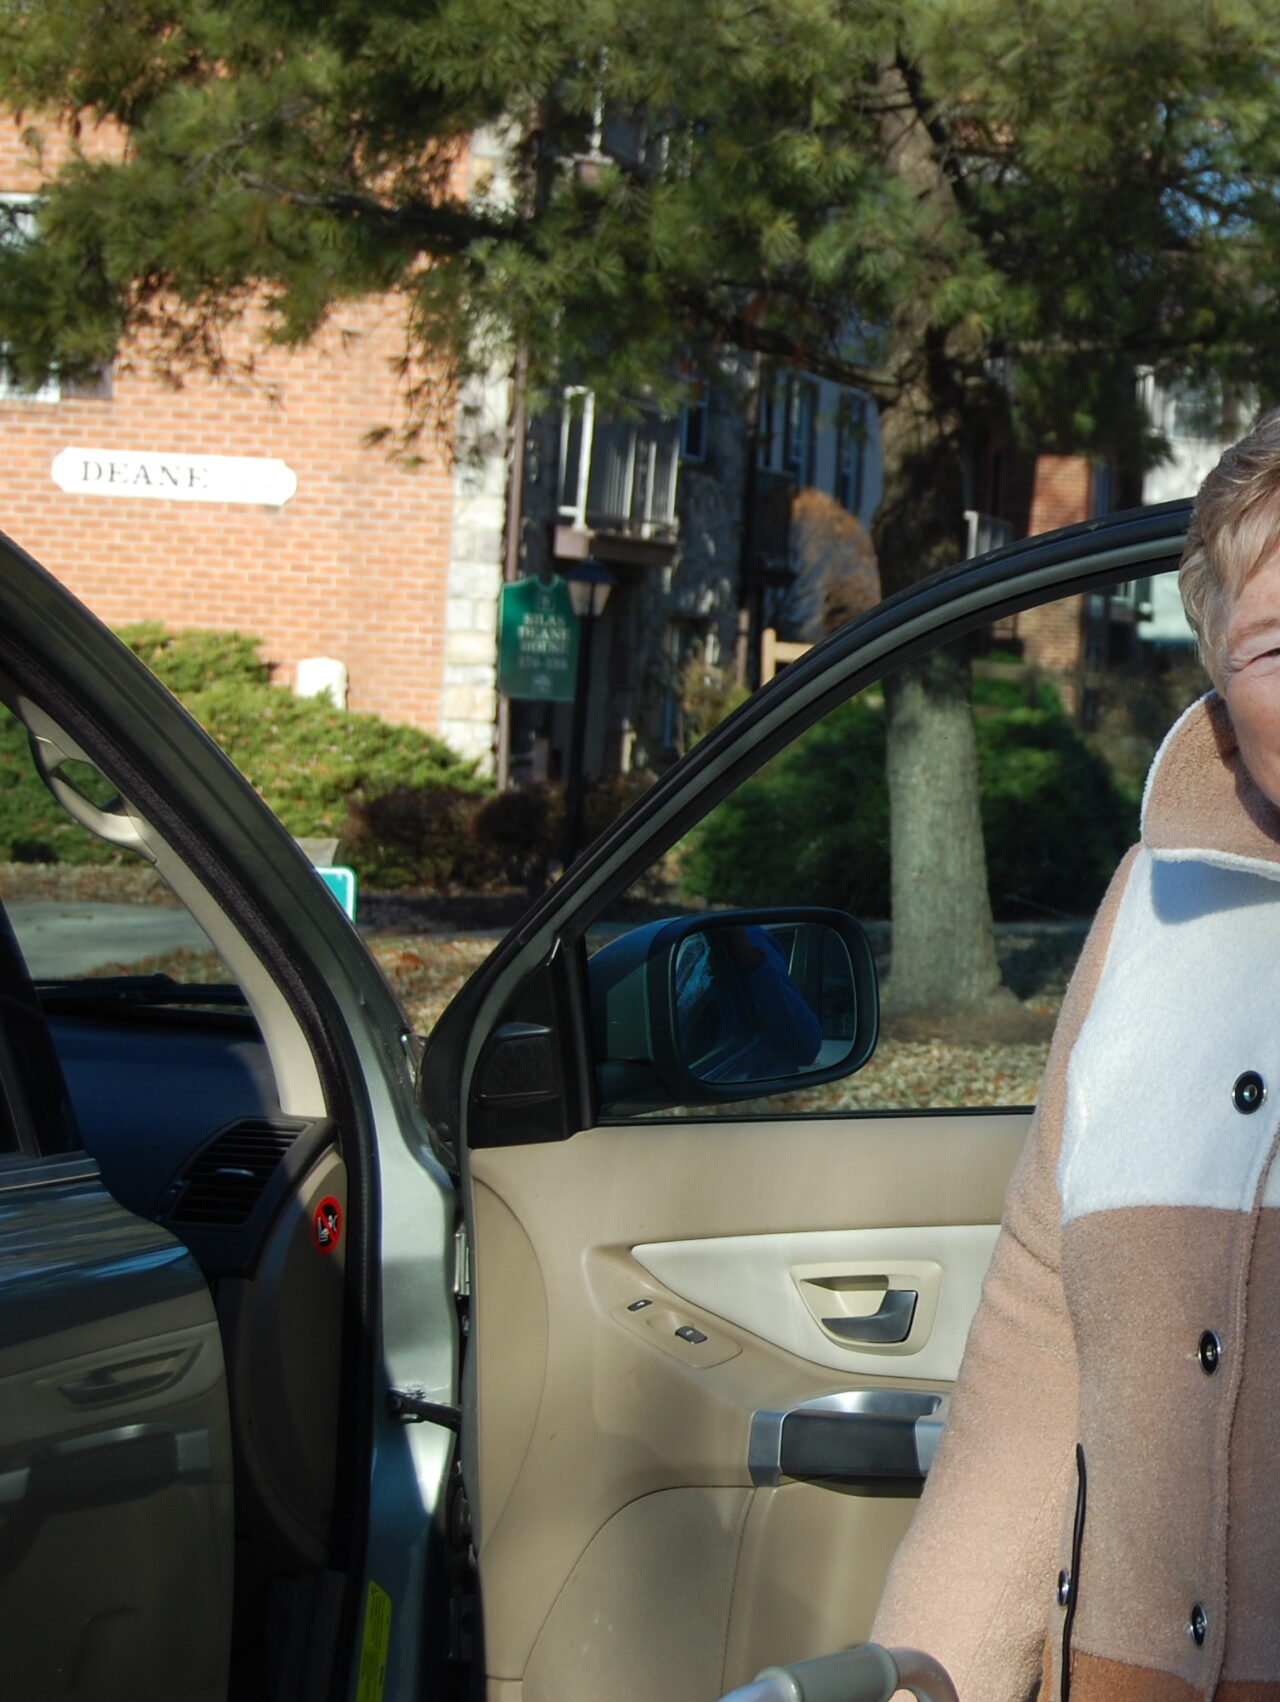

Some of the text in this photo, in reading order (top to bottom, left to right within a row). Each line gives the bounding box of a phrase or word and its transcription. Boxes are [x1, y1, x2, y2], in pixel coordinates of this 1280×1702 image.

[81, 461, 208, 488] DEANE
[523, 612, 566, 625] SILAS
[518, 625, 570, 639] DEANE
[520, 639, 567, 653] HOUSE
